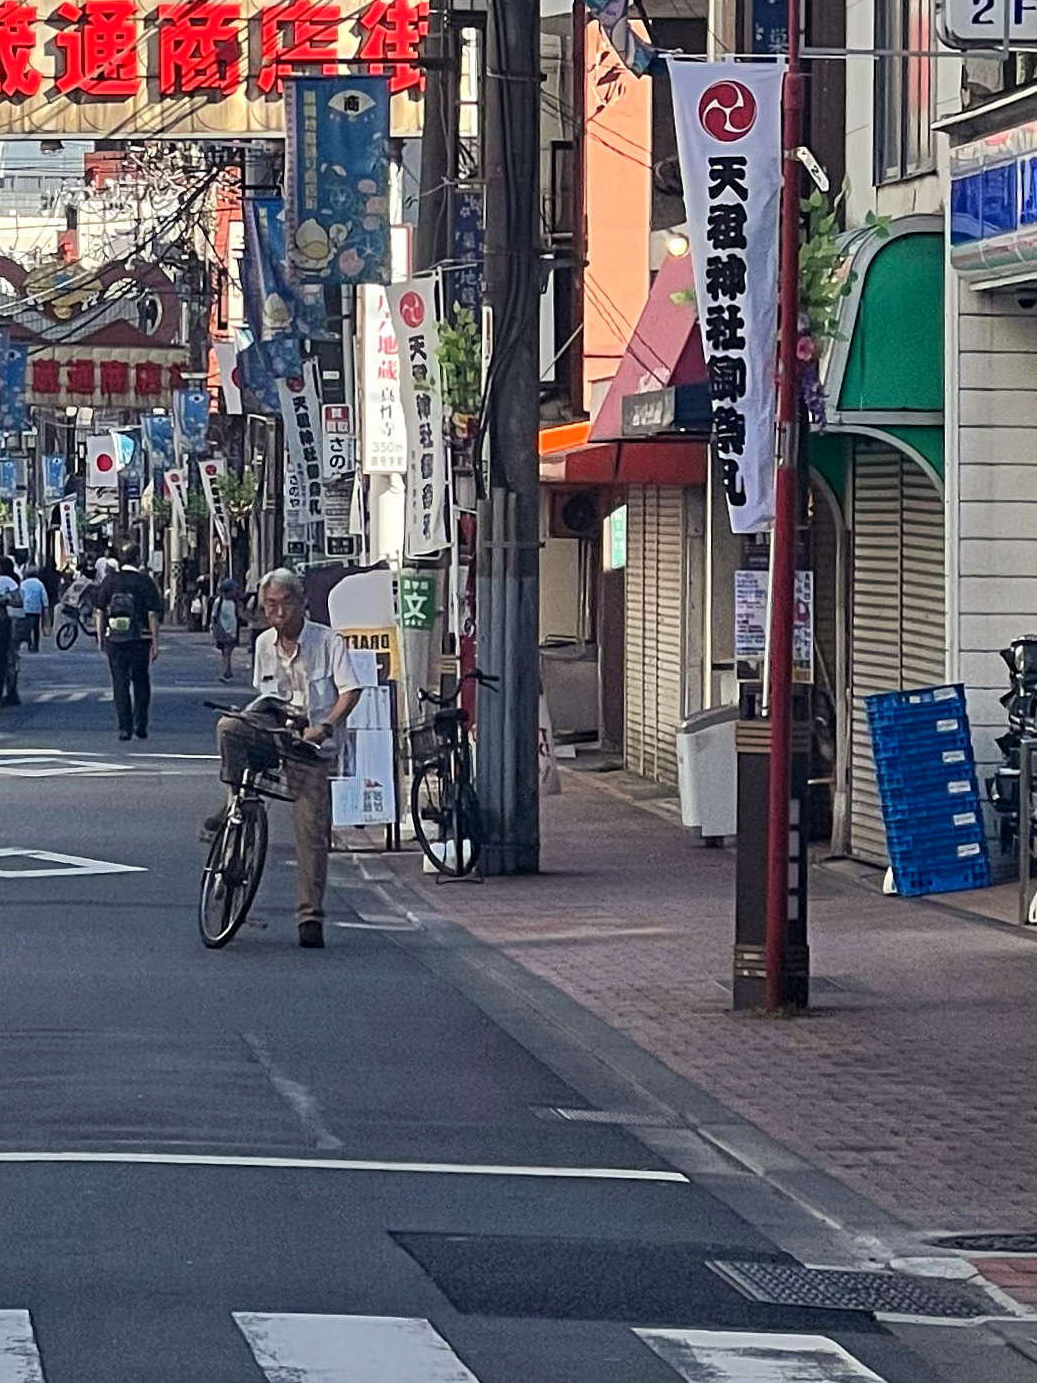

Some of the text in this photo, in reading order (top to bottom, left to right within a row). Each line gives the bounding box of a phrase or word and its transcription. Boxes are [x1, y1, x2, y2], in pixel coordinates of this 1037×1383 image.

[706, 156, 749, 506] 天祖神社御祭礼
[329, 437, 345, 478] さの
[404, 591, 428, 619] 文
